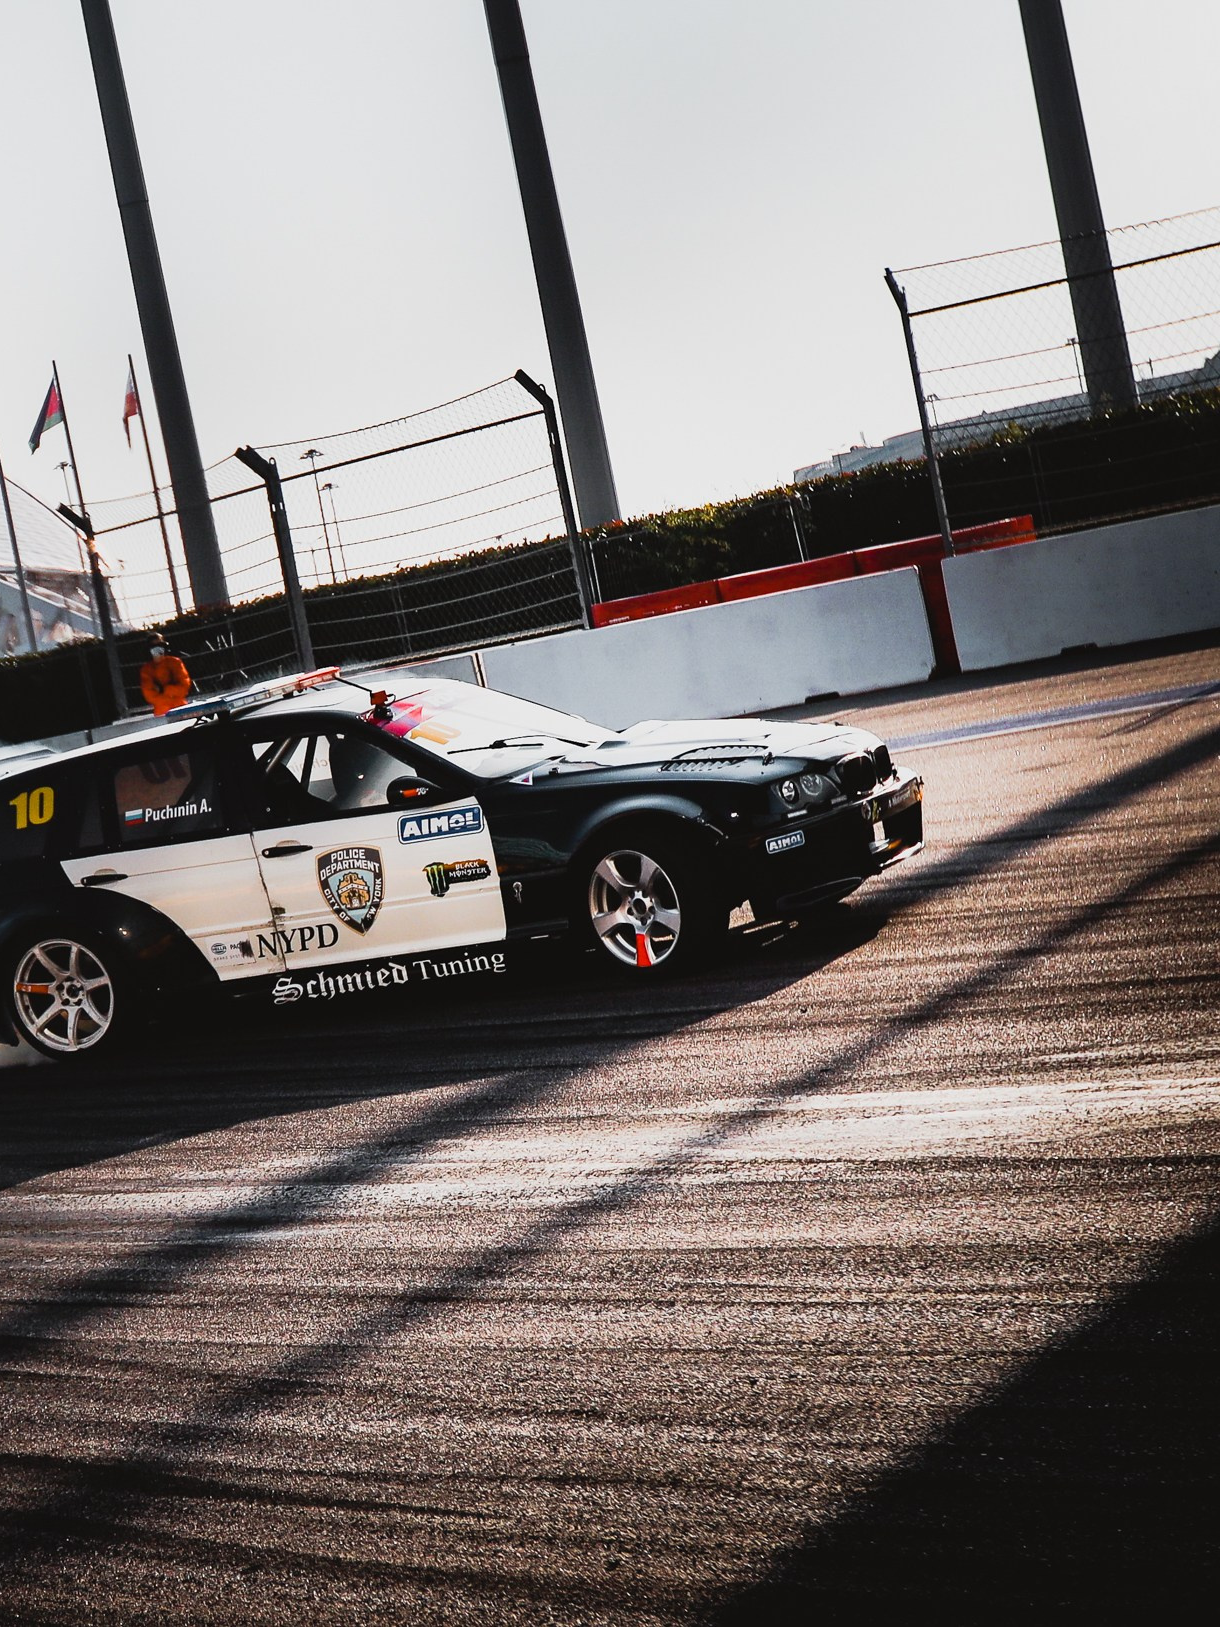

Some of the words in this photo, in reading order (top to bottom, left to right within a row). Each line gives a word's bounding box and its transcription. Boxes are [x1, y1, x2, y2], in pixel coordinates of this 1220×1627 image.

[410, 721, 461, 745] 10
[9, 786, 55, 829] 10
[145, 801, 198, 822] Puchinin
[199, 798, 212, 814] A.
[403, 811, 479, 838] AIMOL
[769, 834, 802, 851] AIMOL
[330, 848, 366, 863] POLICE
[455, 861, 480, 870] BLACK
[320, 859, 380, 880] DEPARTMENT
[449, 867, 487, 878] MONSTER
[324, 888, 340, 910] CITY
[339, 911, 350, 921] OF
[373, 878, 382, 902] YORK
[256, 923, 339, 958] NYPD
[271, 961, 410, 1005] Schmied
[412, 952, 506, 981] Tuning
